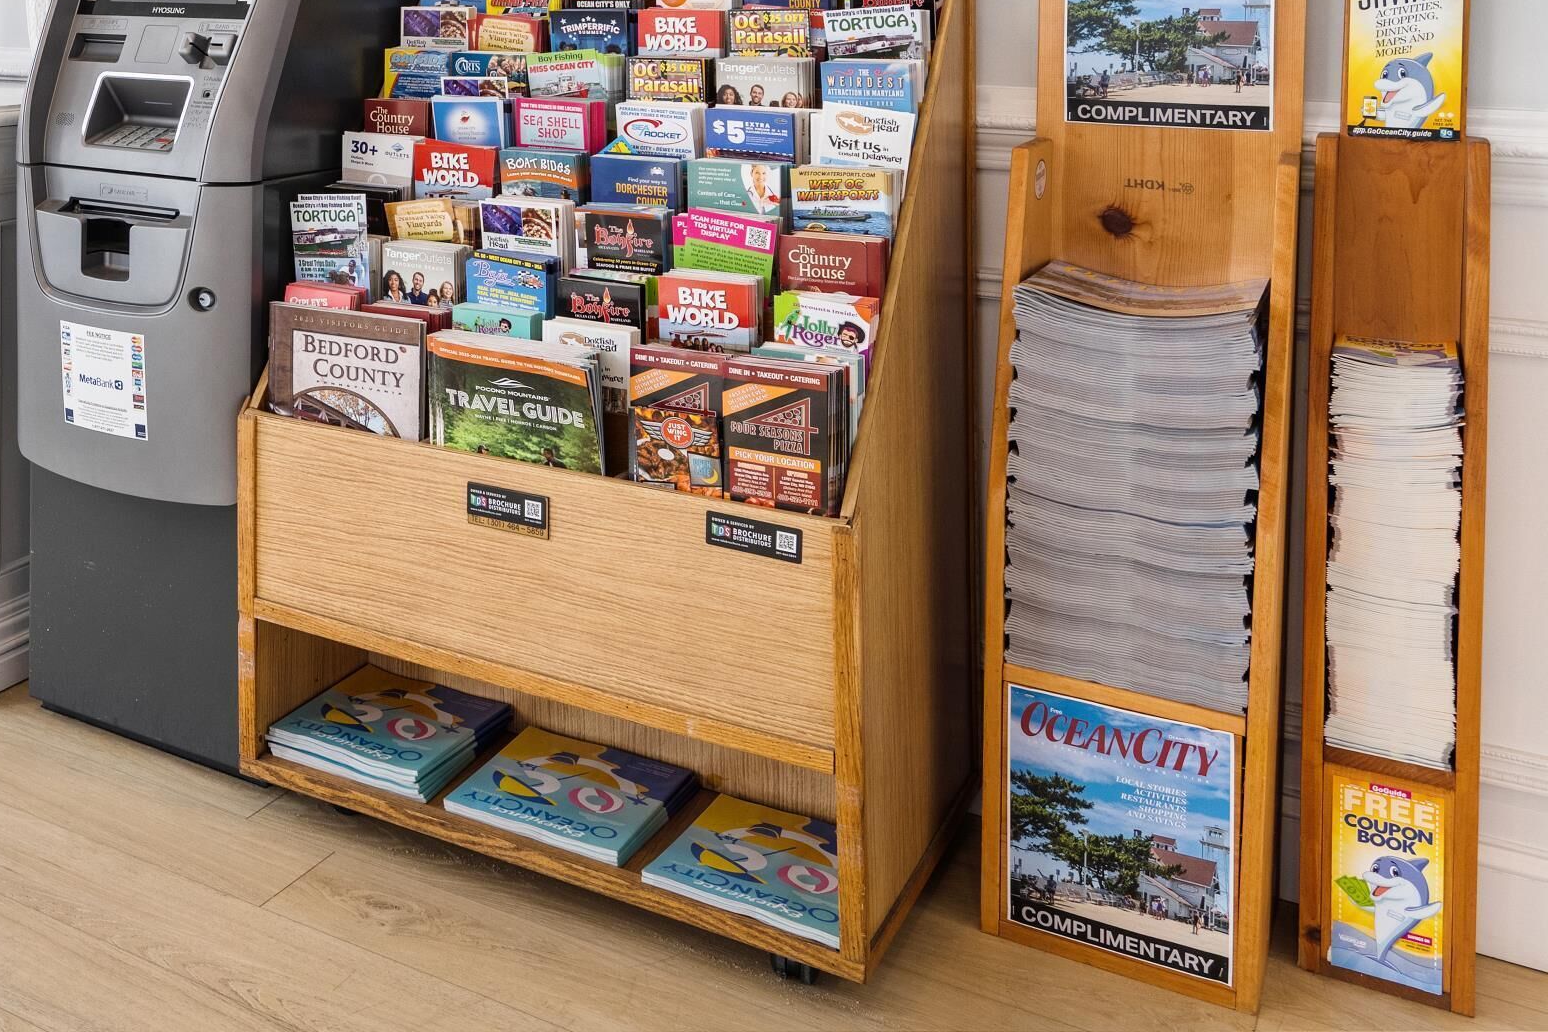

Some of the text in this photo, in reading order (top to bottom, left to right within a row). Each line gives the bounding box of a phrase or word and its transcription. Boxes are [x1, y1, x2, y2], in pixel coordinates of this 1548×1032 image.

[151, 6, 186, 16] HYOSUNG
[654, 16, 697, 34] BIKE
[827, 13, 910, 33] TORTUGA
[644, 33, 708, 52] WORLD
[734, 28, 806, 45] Parasail
[1375, 32, 1435, 48] MAPS AND
[537, 51, 584, 63] Bay Fishing
[1375, 45, 1412, 58] MORE!
[529, 60, 595, 73] MISS OCEAN CITY
[633, 62, 698, 77] OC $25 OFF
[858, 69, 870, 77] THE
[633, 77, 699, 94] Parasail
[827, 76, 904, 89] WEIRDEST
[827, 88, 904, 97] ATTRACTION IN MARYLAND
[370, 110, 414, 125] Country
[376, 106, 389, 115] The
[1077, 104, 1256, 127] COMPLIMENTARY
[376, 122, 410, 134] House
[523, 115, 580, 129] SEA SHELL
[745, 121, 770, 129] EXTRA
[537, 128, 567, 139] SHOP
[350, 140, 378, 156] 30+
[430, 152, 469, 170] BIKE
[422, 168, 480, 188] WORLD
[808, 179, 865, 190] WEST OC
[615, 182, 668, 197] DORCHESTER
[797, 190, 879, 202] WATERSPORTS
[636, 196, 668, 206] COUNTY
[293, 209, 356, 223] TORTUGA
[690, 214, 745, 230] SCAN HERE FOR
[608, 225, 624, 234] The
[700, 229, 731, 240] DISPLAY
[708, 224, 738, 236] VIRTUAL
[798, 244, 815, 255] The
[788, 249, 852, 270] Country
[799, 262, 846, 280] House
[584, 293, 600, 302] The
[677, 286, 727, 309] BIKE
[666, 305, 740, 330] WORLD
[802, 315, 837, 334] Jolly
[792, 323, 841, 347] Roger
[302, 334, 399, 364] BEDFORD
[635, 353, 648, 362] DINE
[660, 357, 685, 366] TAKEOUT
[690, 361, 719, 370] CATERING
[313, 358, 404, 388] COUNTY
[756, 372, 784, 380] TAKEOUT
[790, 376, 821, 386] CATERING
[79, 373, 115, 389] MetaBank
[475, 385, 549, 402] POCONO MOUNTAINS
[446, 388, 585, 429] TRAVEL GUIDE
[667, 428, 688, 436] WING
[730, 421, 803, 442] FOUR SEASONS
[773, 439, 804, 454] PIZZA
[734, 449, 815, 469] PICK YOUR LOCATION
[488, 498, 522, 511] BROCHURE
[488, 505, 521, 516] DISTRIBUTORS
[732, 528, 772, 542] BROCHURE
[732, 535, 772, 548] DISTRIBUTORS
[1343, 788, 1436, 828] FREE
[1344, 813, 1434, 845] COUPON
[1357, 829, 1416, 855] BOOK
[1021, 905, 1214, 975] COMPLIMENTARY
